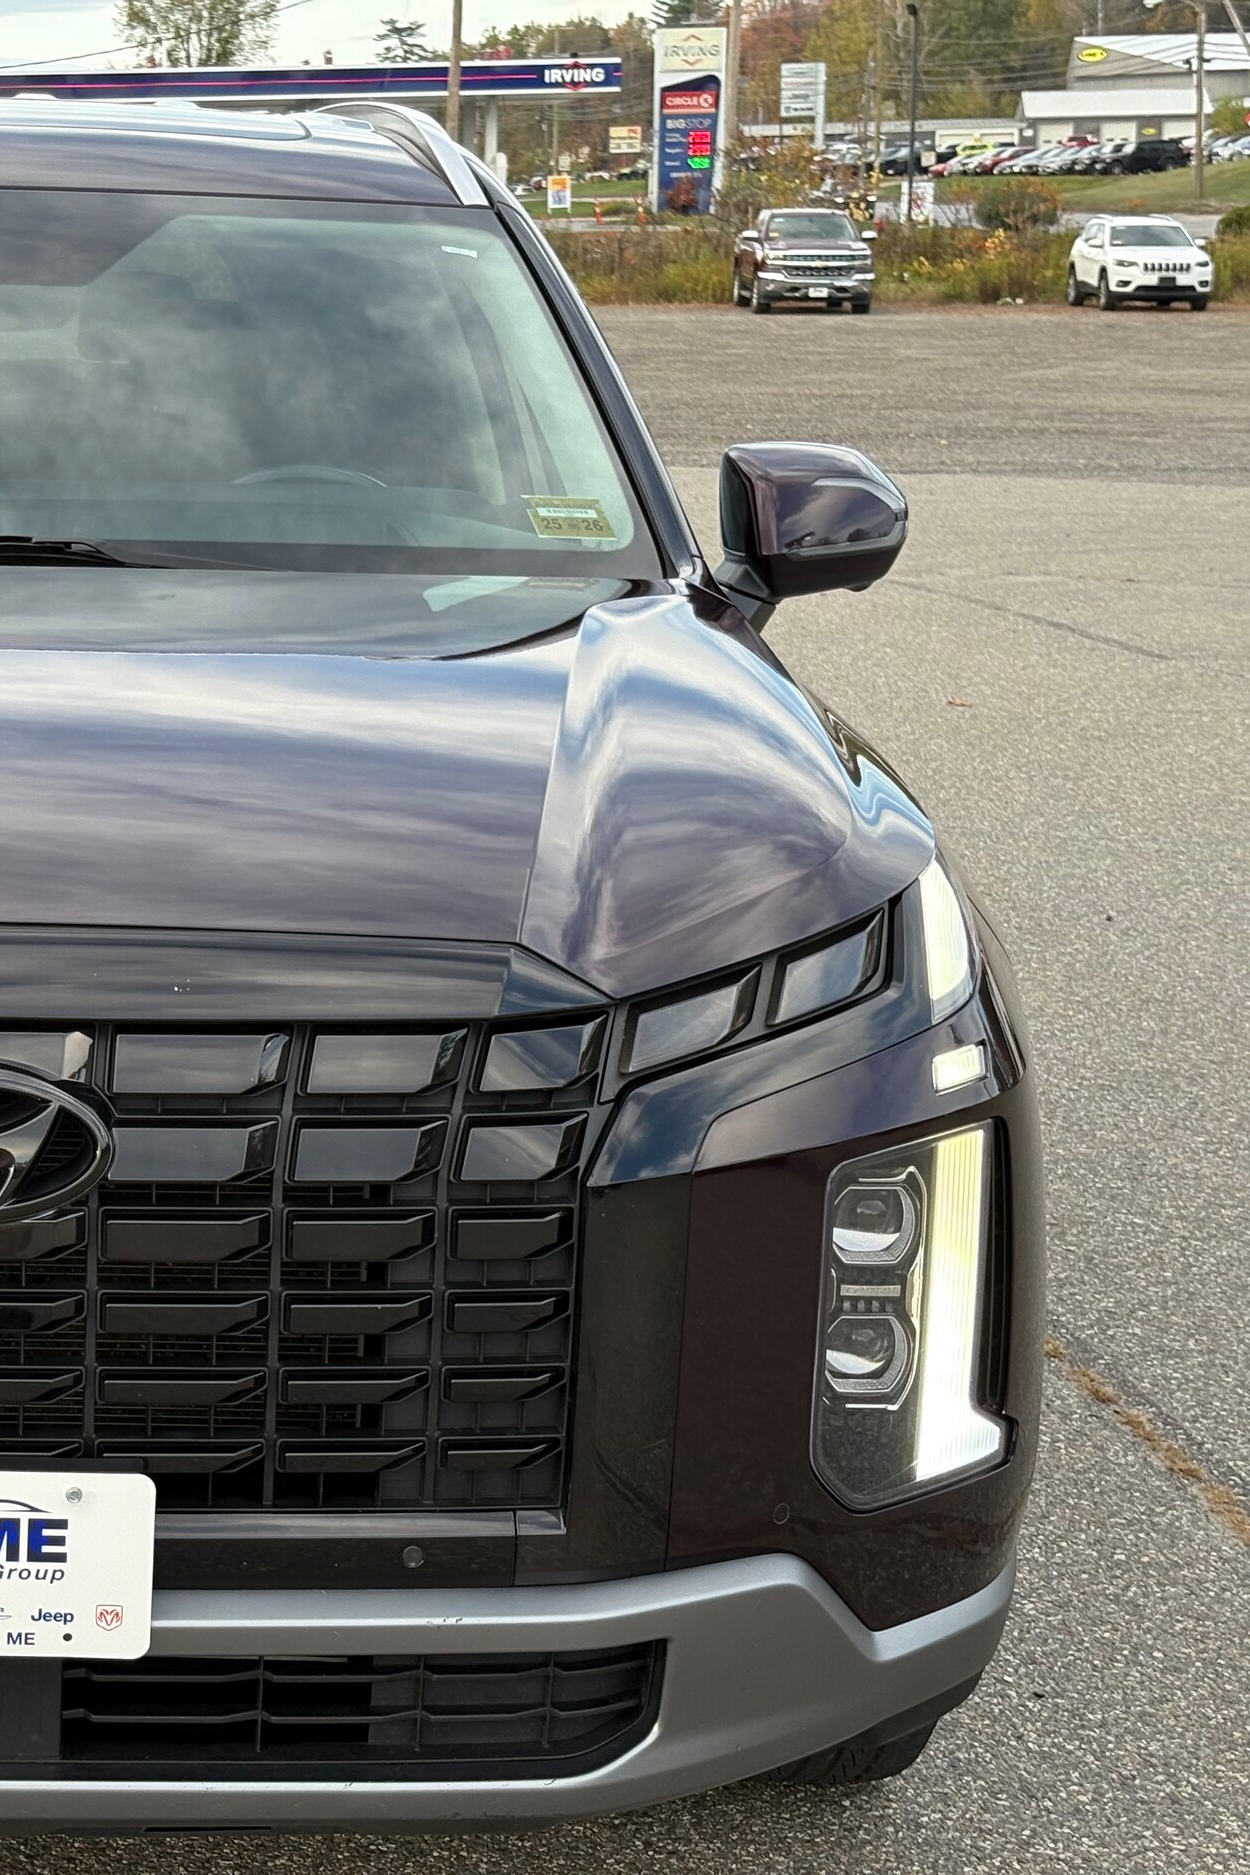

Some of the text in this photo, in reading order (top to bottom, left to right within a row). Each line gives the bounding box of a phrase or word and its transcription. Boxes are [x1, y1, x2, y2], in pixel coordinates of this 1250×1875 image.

[544, 68, 605, 83] IRVING
[541, 518, 603, 531] 25 26
[30, 1608, 74, 1625] Jeep
[7, 1632, 36, 1646] ME
